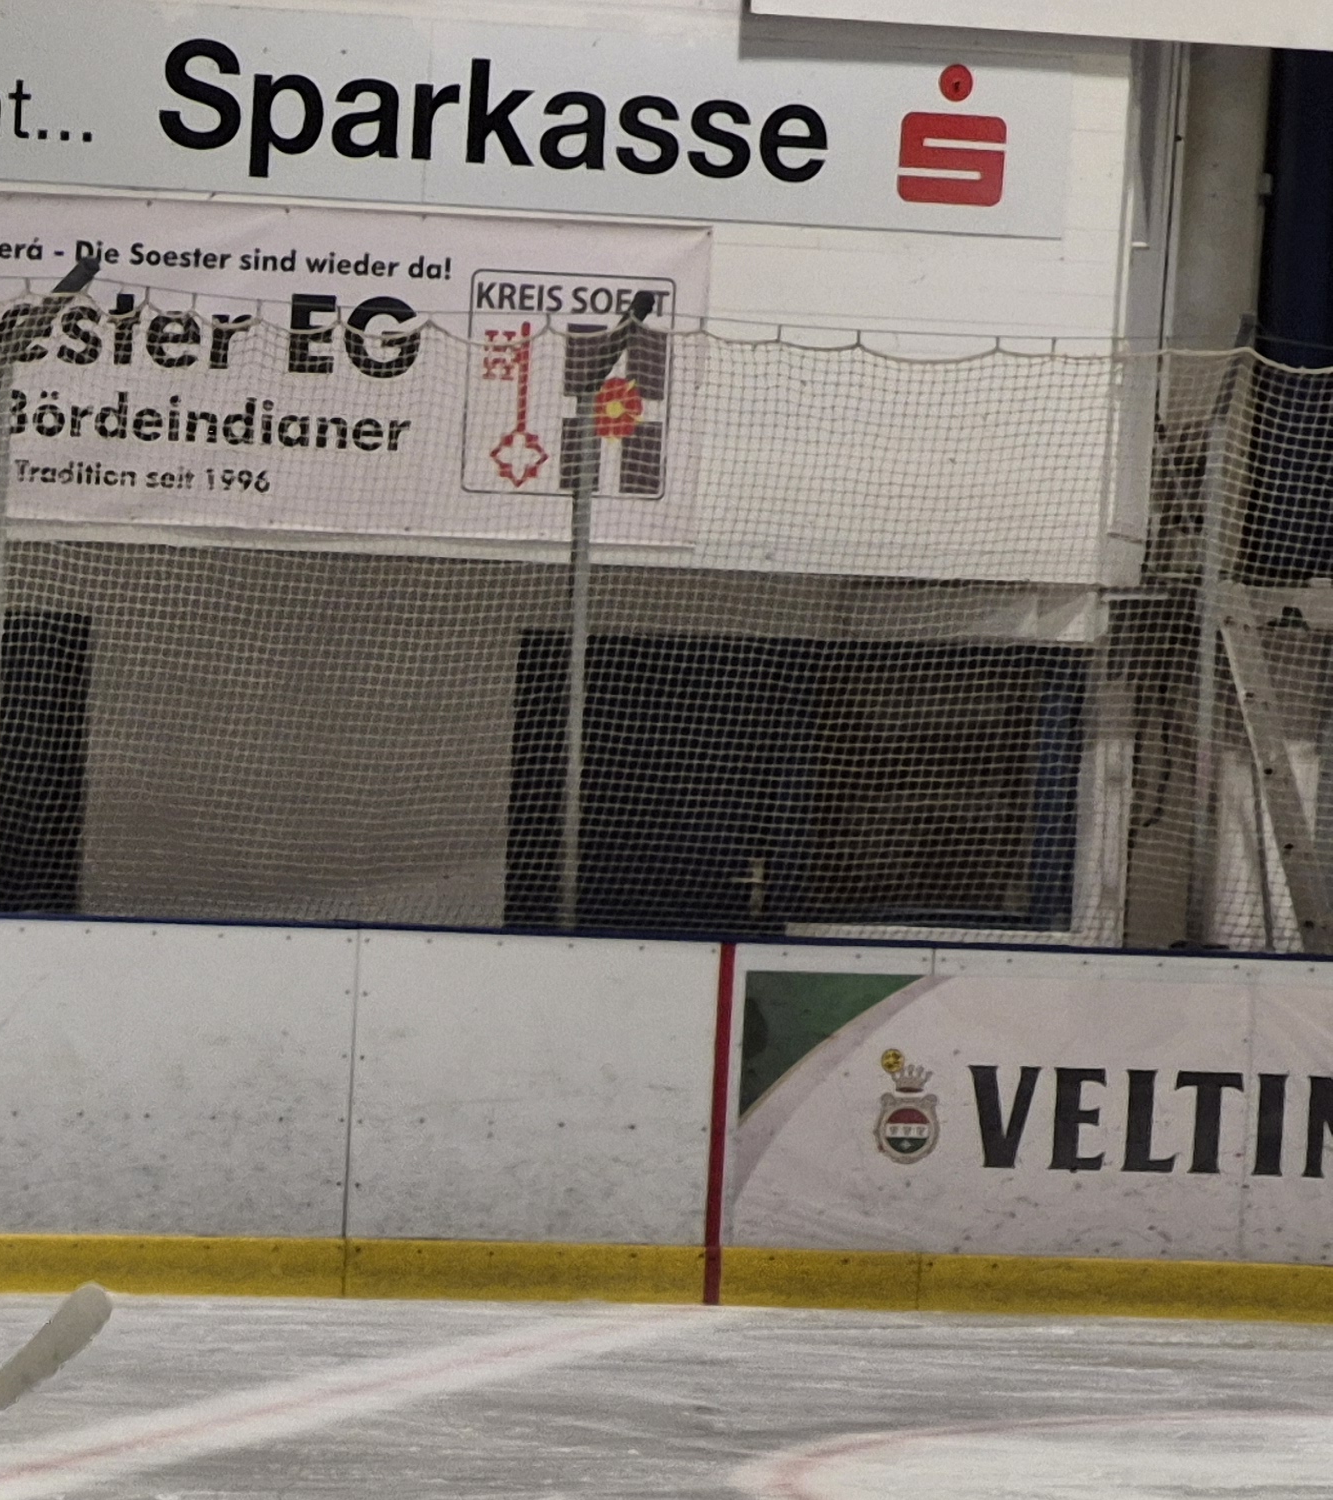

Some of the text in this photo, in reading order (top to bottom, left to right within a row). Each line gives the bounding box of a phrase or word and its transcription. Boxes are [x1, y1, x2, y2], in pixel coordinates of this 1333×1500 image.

[159, 37, 829, 183] Sparkasse
[75, 240, 120, 265] Die
[130, 242, 232, 270] Soester
[238, 248, 297, 273] sind
[305, 252, 401, 278] wieder
[408, 255, 453, 280] da!
[476, 281, 670, 318] KREIS SOET
[287, 292, 423, 380] EG
[5, 389, 412, 452] Bördeindianer
[14, 458, 271, 494] Tradition seit 1996
